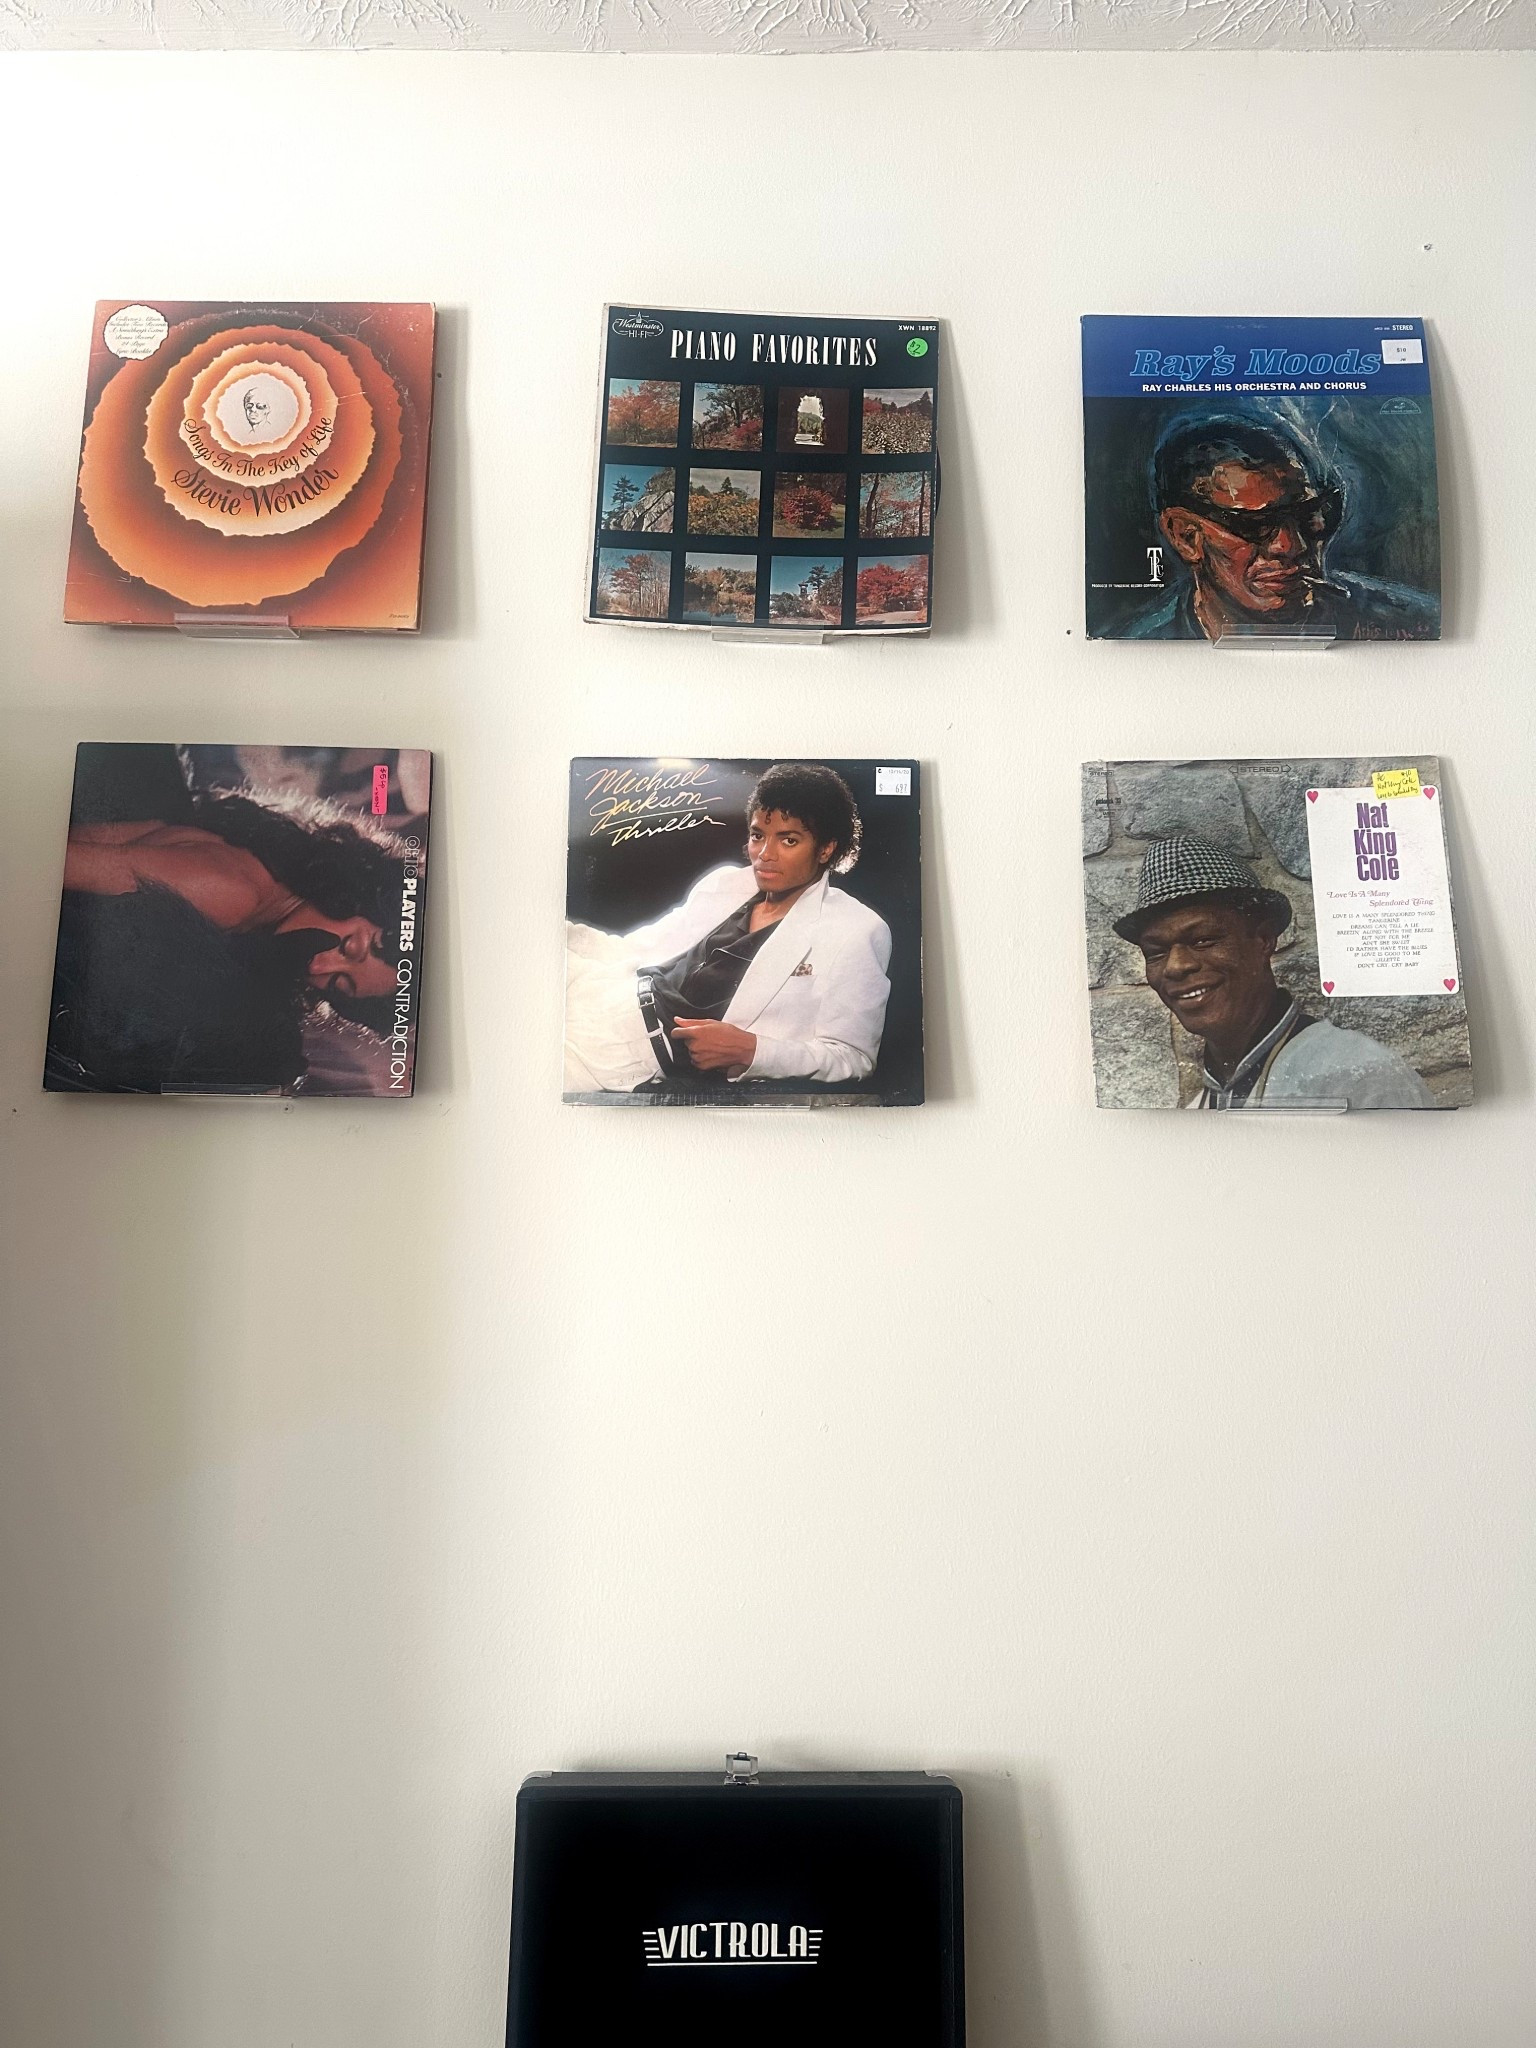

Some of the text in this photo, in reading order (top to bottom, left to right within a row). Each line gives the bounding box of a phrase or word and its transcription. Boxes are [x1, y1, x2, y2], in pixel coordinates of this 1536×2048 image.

[614, 318, 661, 331] Westminster
[628, 330, 647, 339] HI-FI
[669, 329, 877, 367] PIANO FAVORITES
[1129, 345, 1382, 382] Ray's Moods
[1142, 381, 1367, 392] RAY CHARLES HIS ORCHESTRA AND CHORUS
[183, 417, 334, 477] Songs In The Key of Life
[170, 468, 339, 517] Stevie Wonder
[584, 763, 718, 800] Michael
[589, 791, 723, 836] Jackson
[607, 812, 726, 846] Thriller
[1356, 802, 1389, 829] Nat
[1354, 829, 1397, 857] King
[1356, 855, 1400, 881] Cole
[1367, 890, 1391, 898] Many
[1411, 898, 1434, 907] Thing
[399, 878, 417, 952] PLAYERS
[388, 958, 413, 1089] CONTRADICTION
[657, 1922, 808, 1958] VICTROLA
